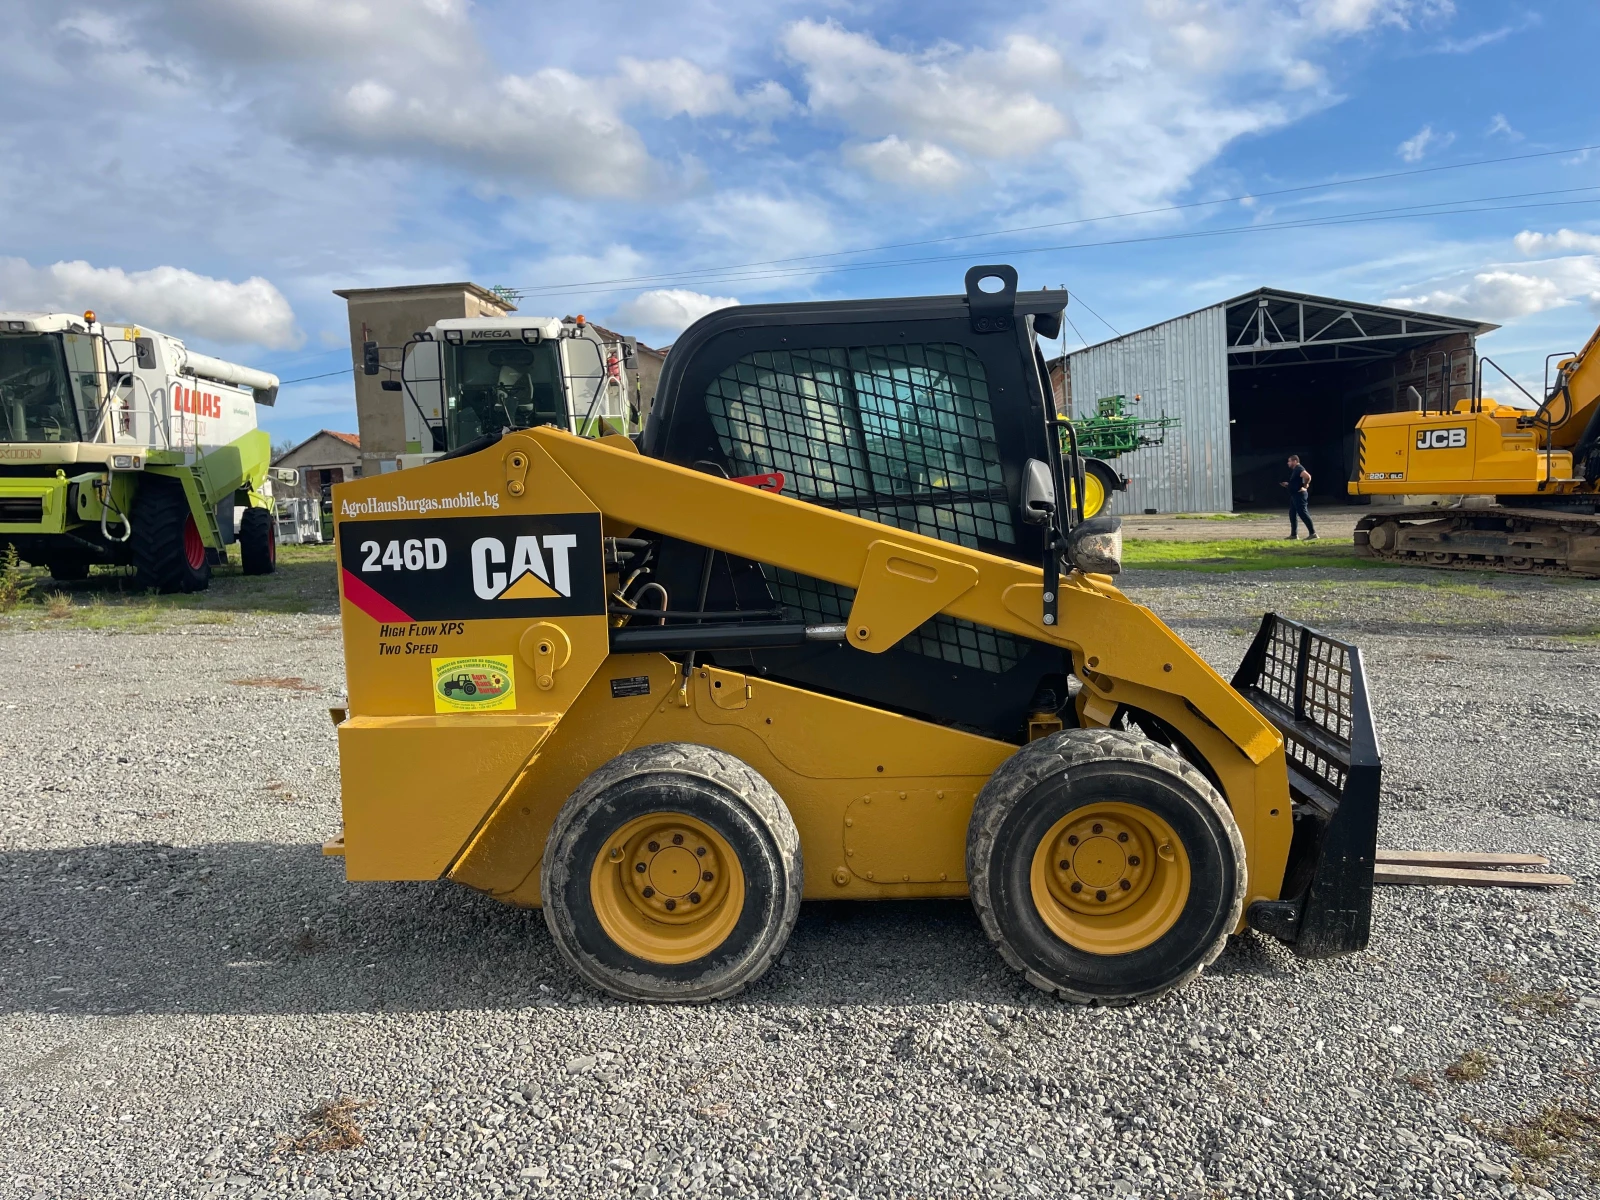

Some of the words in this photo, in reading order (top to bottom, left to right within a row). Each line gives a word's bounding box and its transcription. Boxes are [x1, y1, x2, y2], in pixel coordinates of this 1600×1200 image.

[471, 330, 512, 339] MEGA
[1417, 429, 1466, 449] JCB
[340, 491, 500, 518] AgroHausBurgas.mobile.bg
[360, 537, 448, 572] 246D
[470, 534, 577, 600] CAT
[438, 622, 465, 636] XPS
